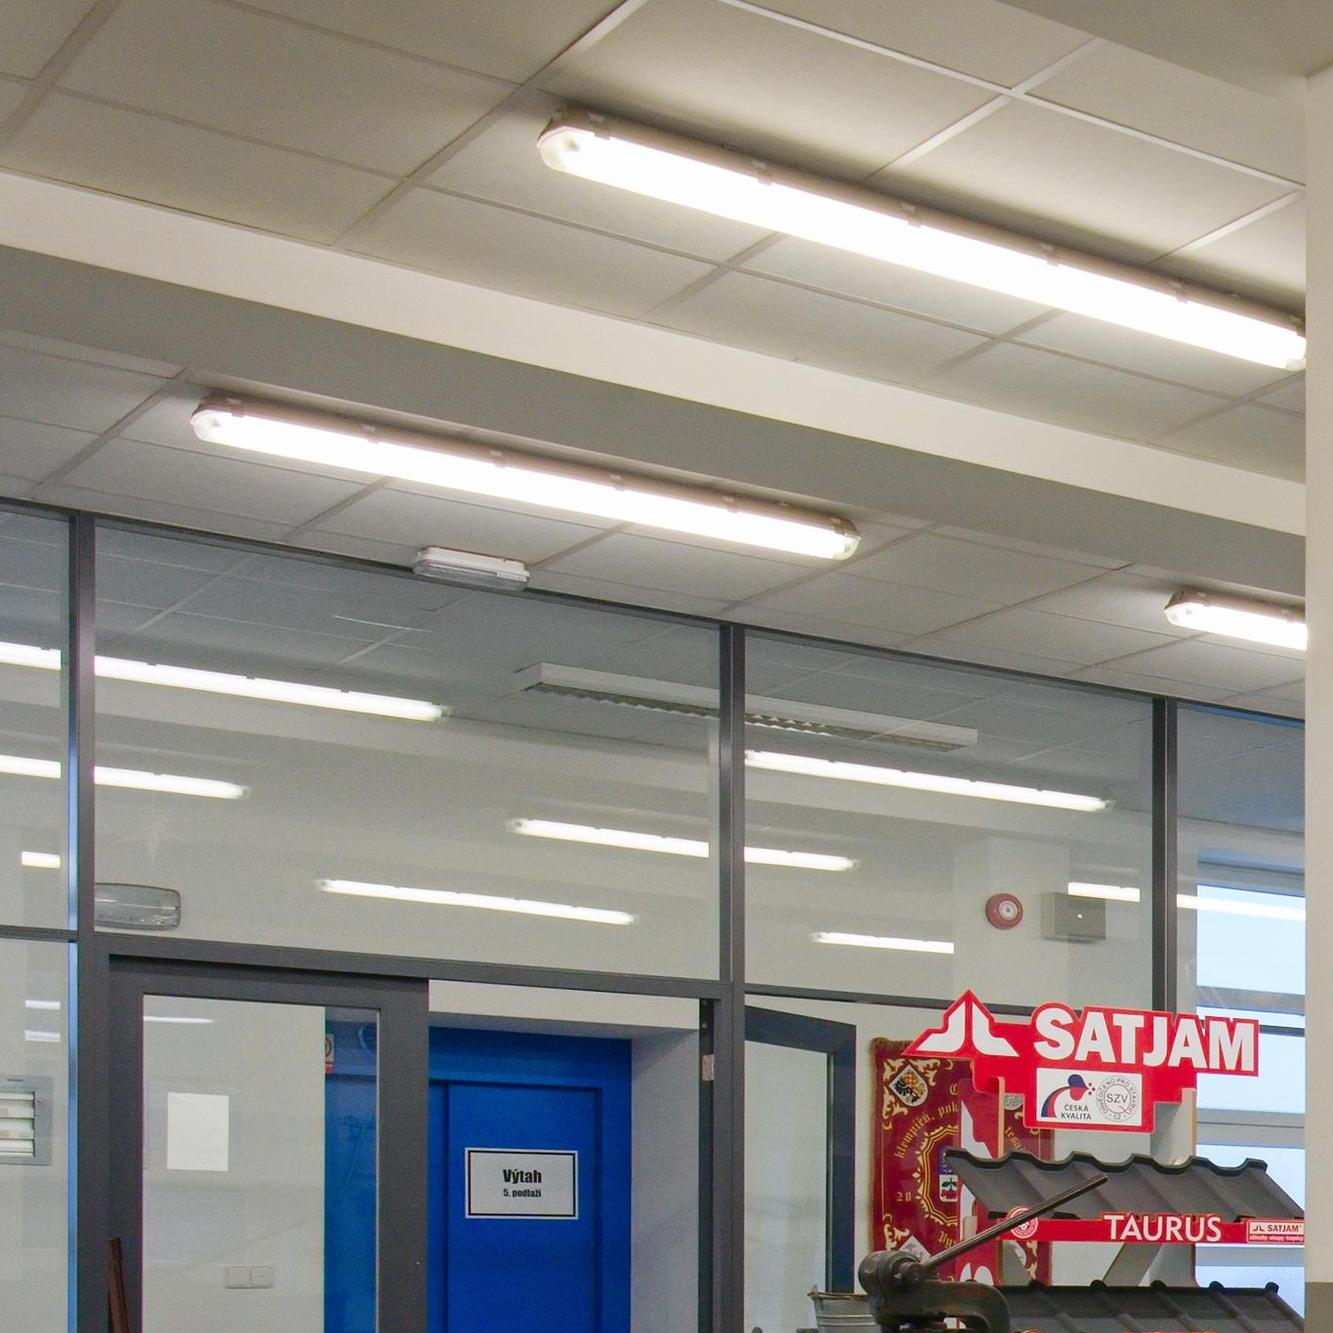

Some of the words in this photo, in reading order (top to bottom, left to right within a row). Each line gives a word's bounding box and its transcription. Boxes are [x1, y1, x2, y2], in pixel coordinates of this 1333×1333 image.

[1033, 1008, 1255, 1072] SATJAM
[1106, 1093, 1128, 1103] SZV
[1061, 1112, 1092, 1120] KVALITA
[503, 1168, 542, 1184] Výtah
[1104, 1215, 1221, 1242] TAURUS
